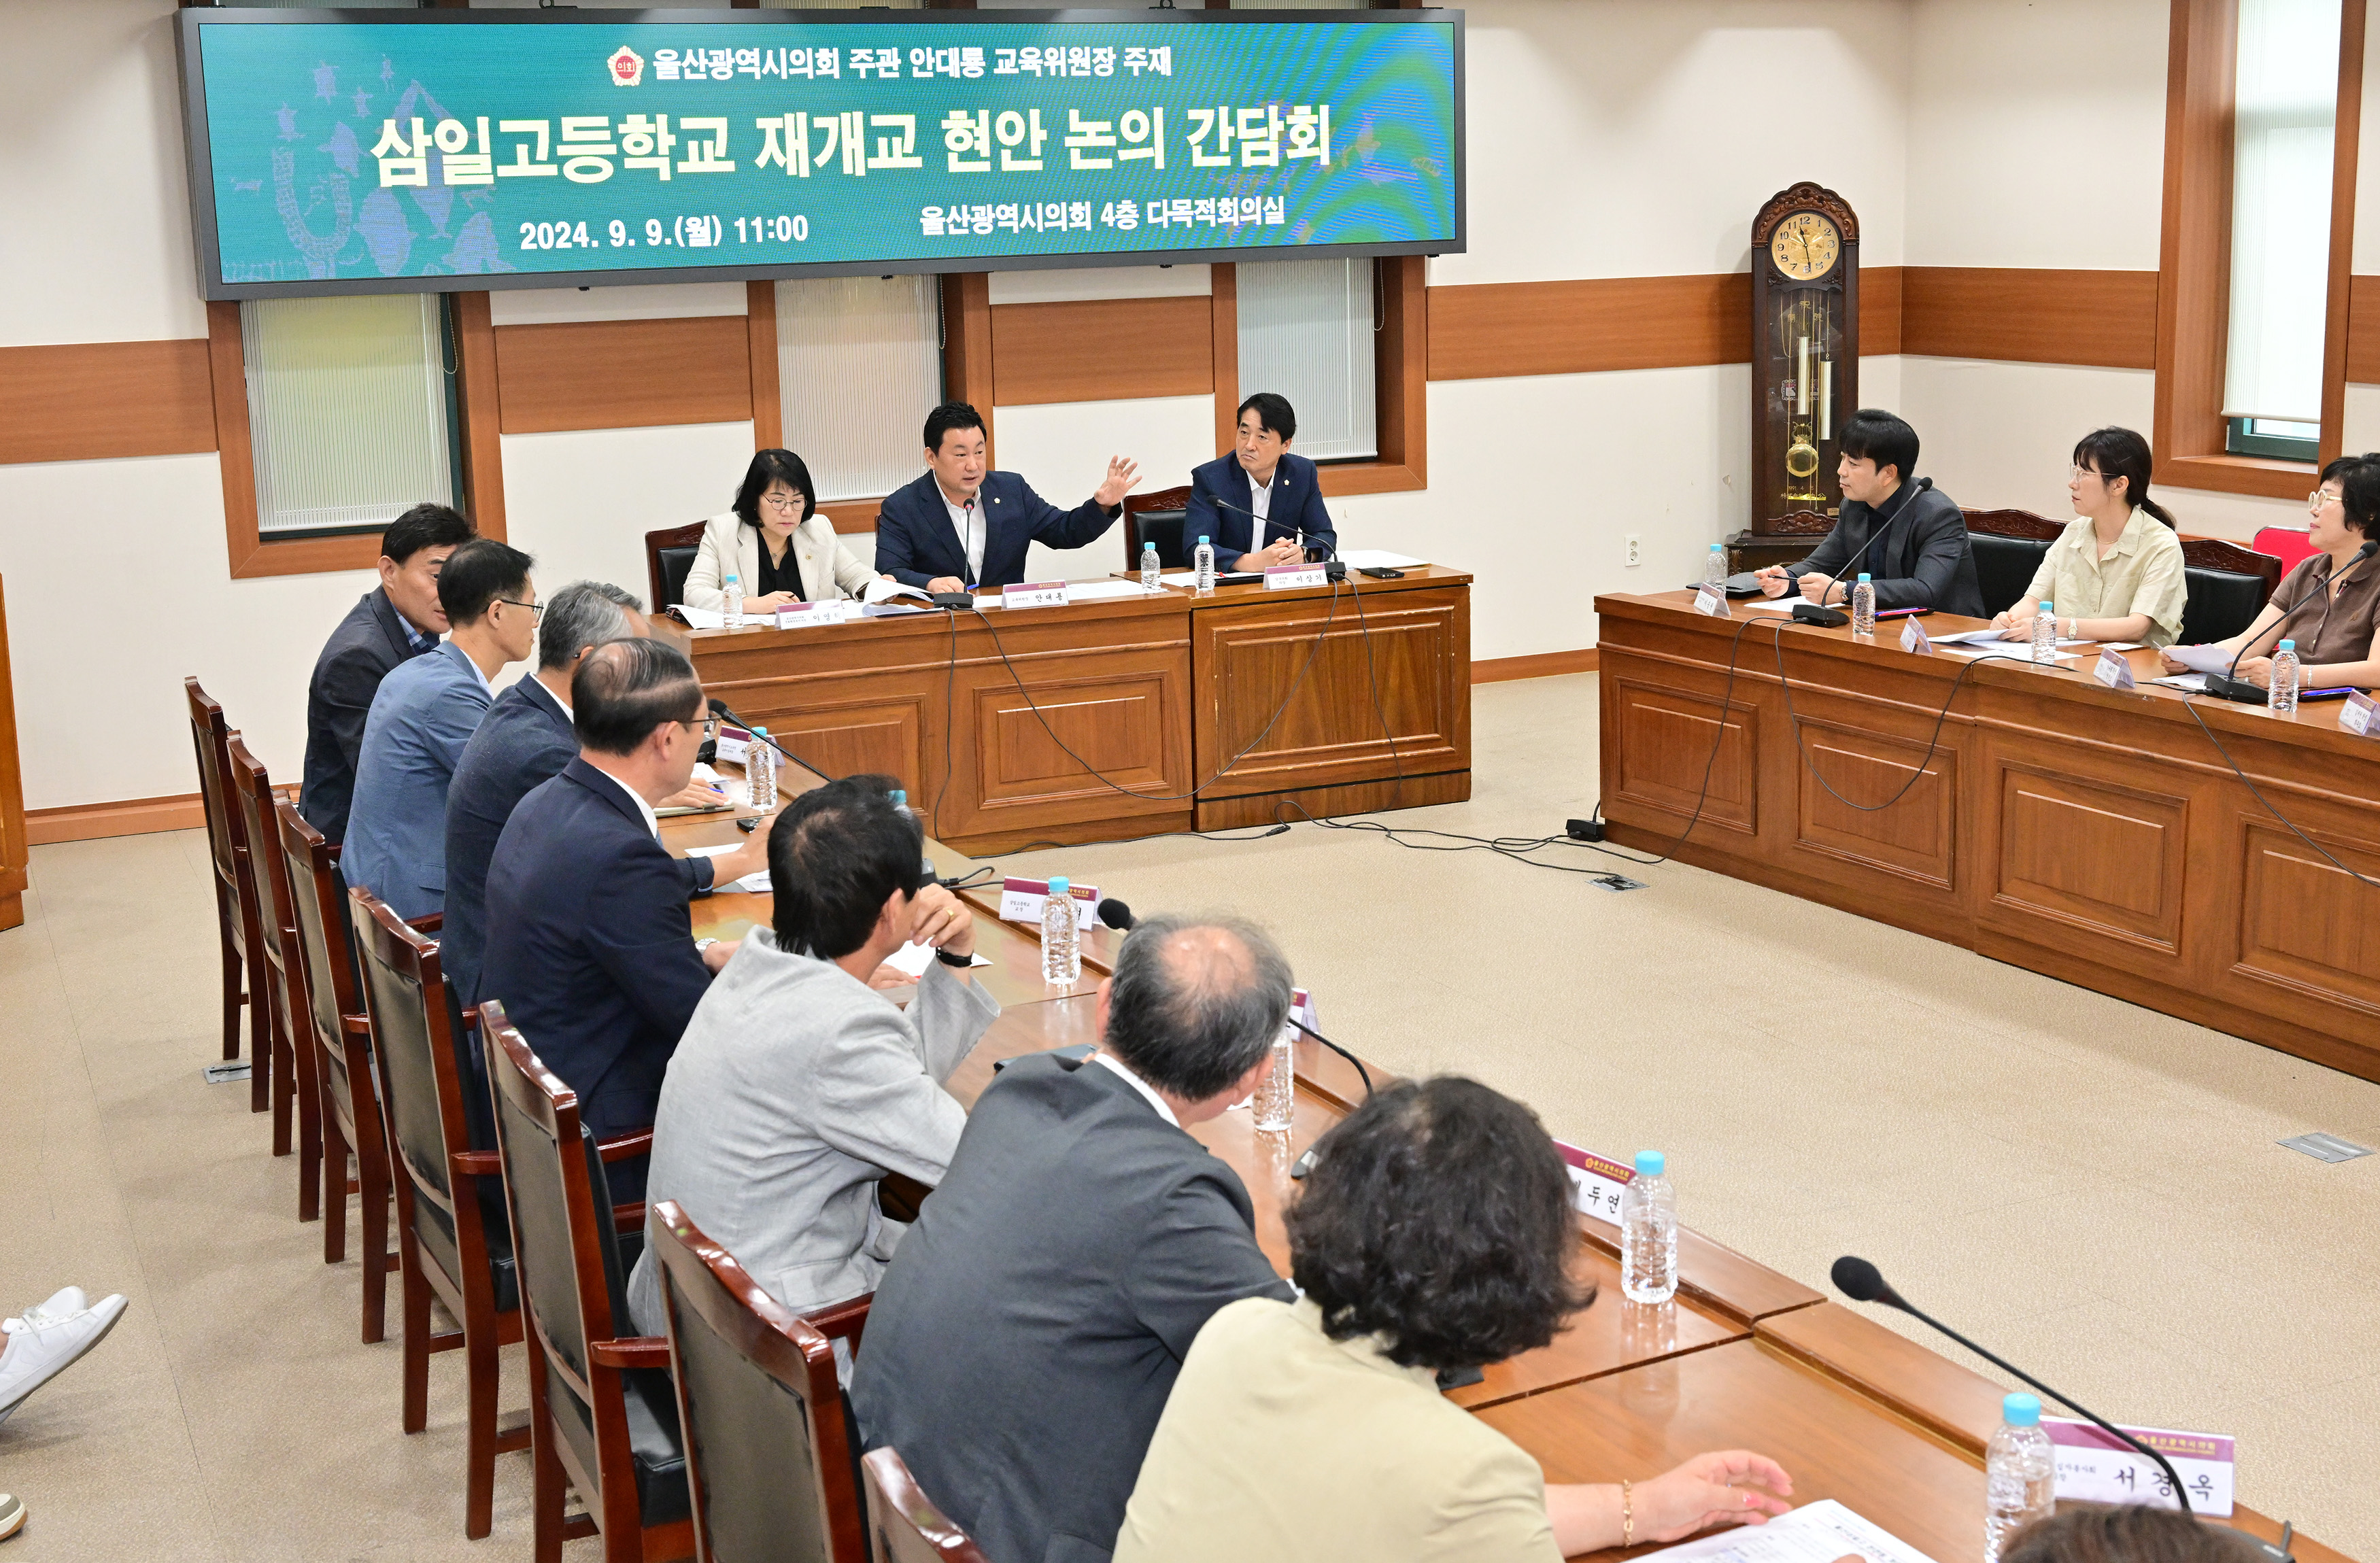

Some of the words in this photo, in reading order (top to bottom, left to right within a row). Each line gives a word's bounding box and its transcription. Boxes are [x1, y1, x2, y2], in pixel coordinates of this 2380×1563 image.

[653, 48, 840, 80] 울산광역시의회
[849, 47, 902, 79] 주관
[909, 46, 986, 78] 안대룡
[993, 46, 1117, 78] 교육위원장
[1123, 46, 1172, 76] 주재
[370, 113, 736, 188] 삼일고등학교
[754, 111, 923, 178] 재개교
[941, 108, 1047, 173] 현안
[1064, 107, 1165, 170] 논의
[1186, 105, 1331, 167] 간담회
[919, 201, 1091, 236] 울산광역시의회
[1100, 199, 1140, 230] 4층
[1147, 195, 1285, 229] 다목적회의실
[1788, 221, 1796, 229] 11
[1800, 216, 1810, 225] 12
[520, 221, 599, 250] 2024.
[609, 220, 635, 247] 9.
[645, 215, 722, 248] 9.(월)
[734, 214, 809, 243] 11:00
[1780, 231, 1789, 239] 10
[1824, 228, 1831, 236] 2
[1827, 240, 1835, 248] 3
[1781, 254, 1788, 262] 8
[1816, 261, 1824, 270] 5
